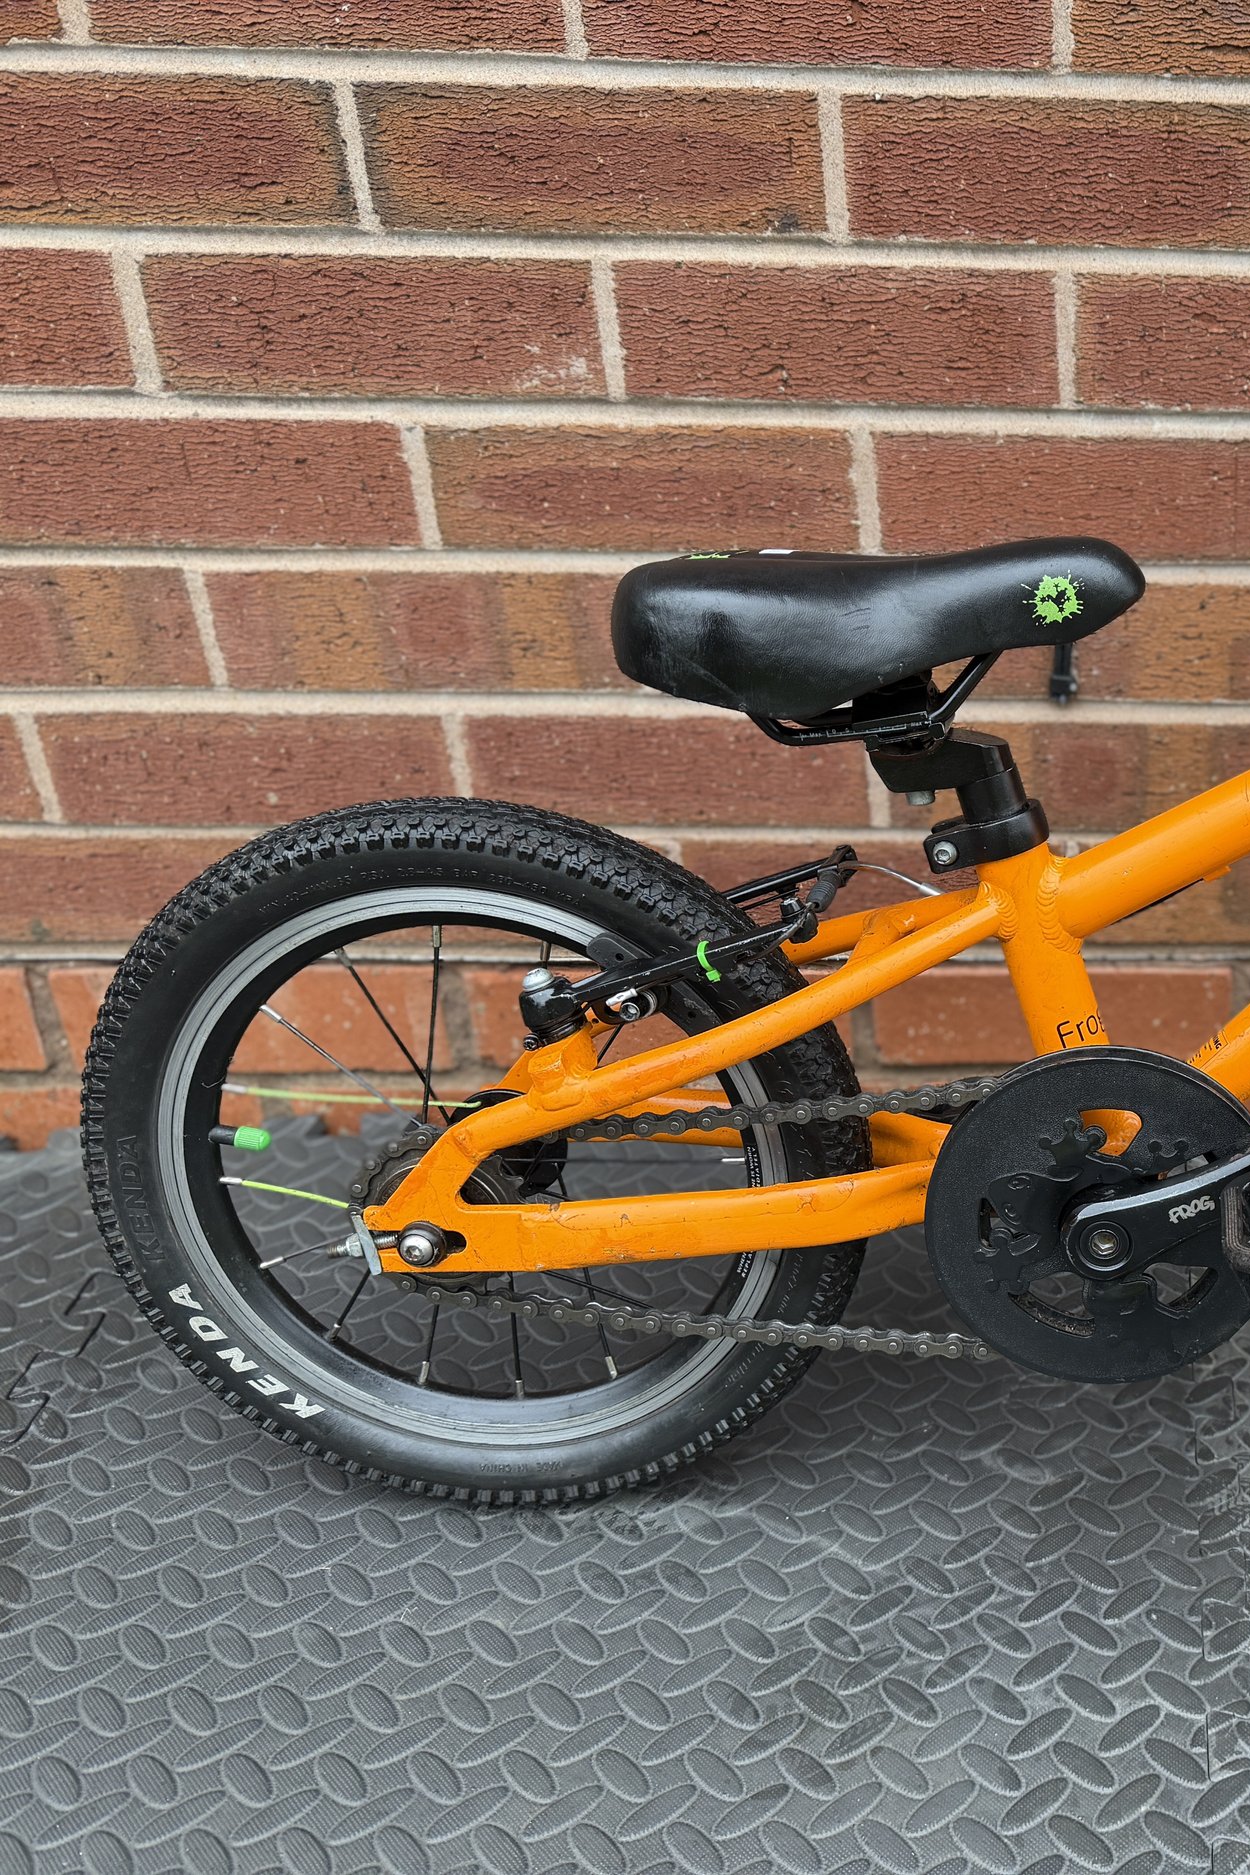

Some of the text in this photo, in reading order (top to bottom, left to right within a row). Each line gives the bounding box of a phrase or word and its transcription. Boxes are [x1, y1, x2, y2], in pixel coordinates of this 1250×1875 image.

[115, 1134, 167, 1263] KENDA
[1168, 1195, 1216, 1224] FROG
[168, 1282, 327, 1420] KENDA
